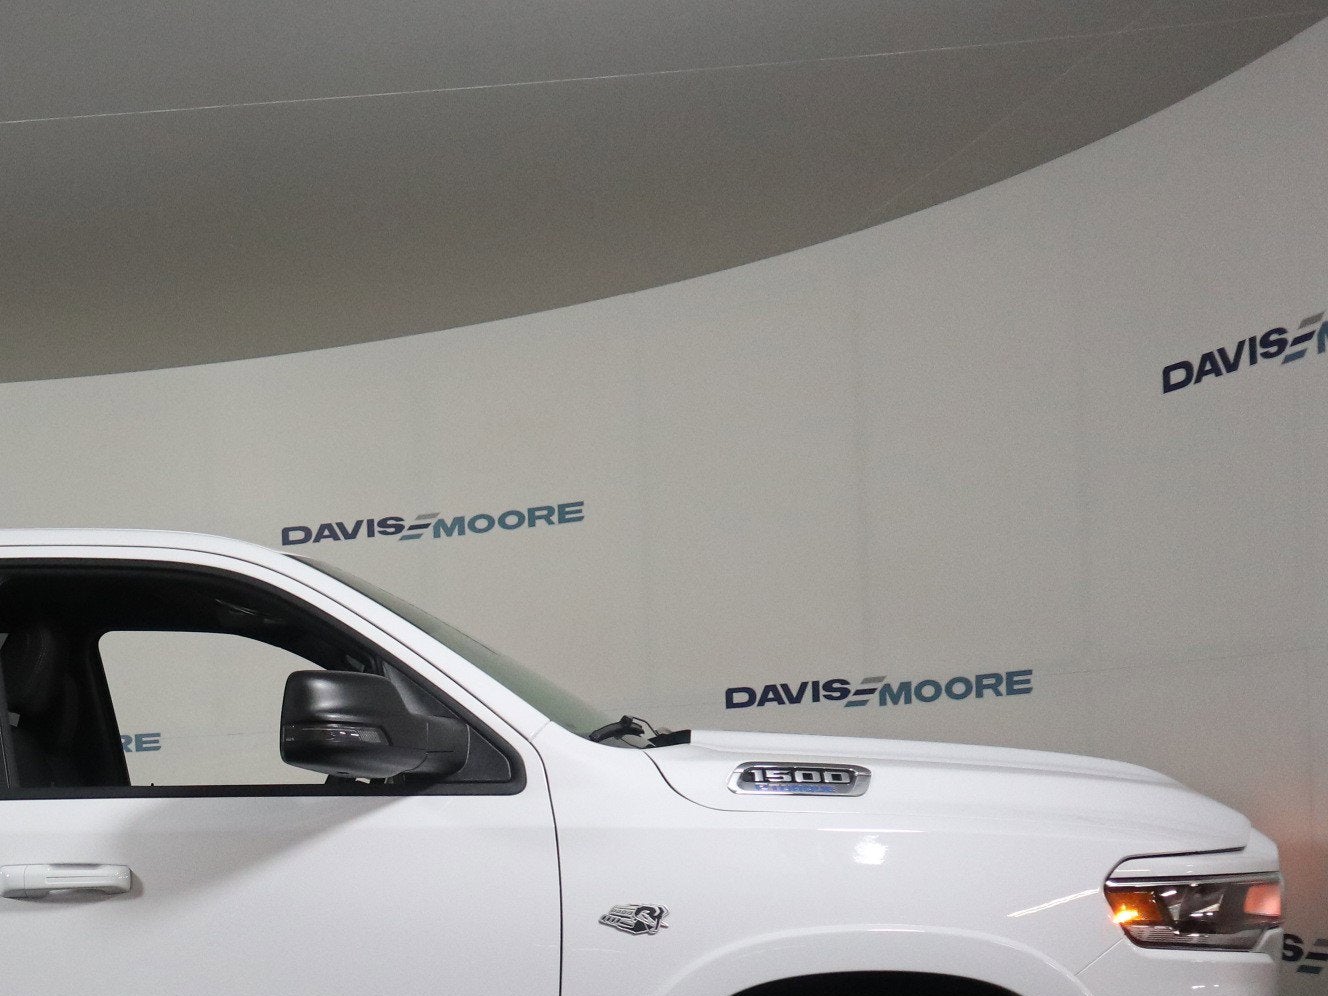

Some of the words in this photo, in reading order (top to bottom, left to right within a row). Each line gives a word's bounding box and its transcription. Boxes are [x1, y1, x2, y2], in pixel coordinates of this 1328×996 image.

[1162, 327, 1289, 394] DAVIS
[281, 516, 405, 546] DAVIS
[432, 501, 584, 538] MOORE
[725, 678, 851, 709] DAVIS
[878, 669, 1033, 707] MOORE
[750, 769, 852, 783] 1500
